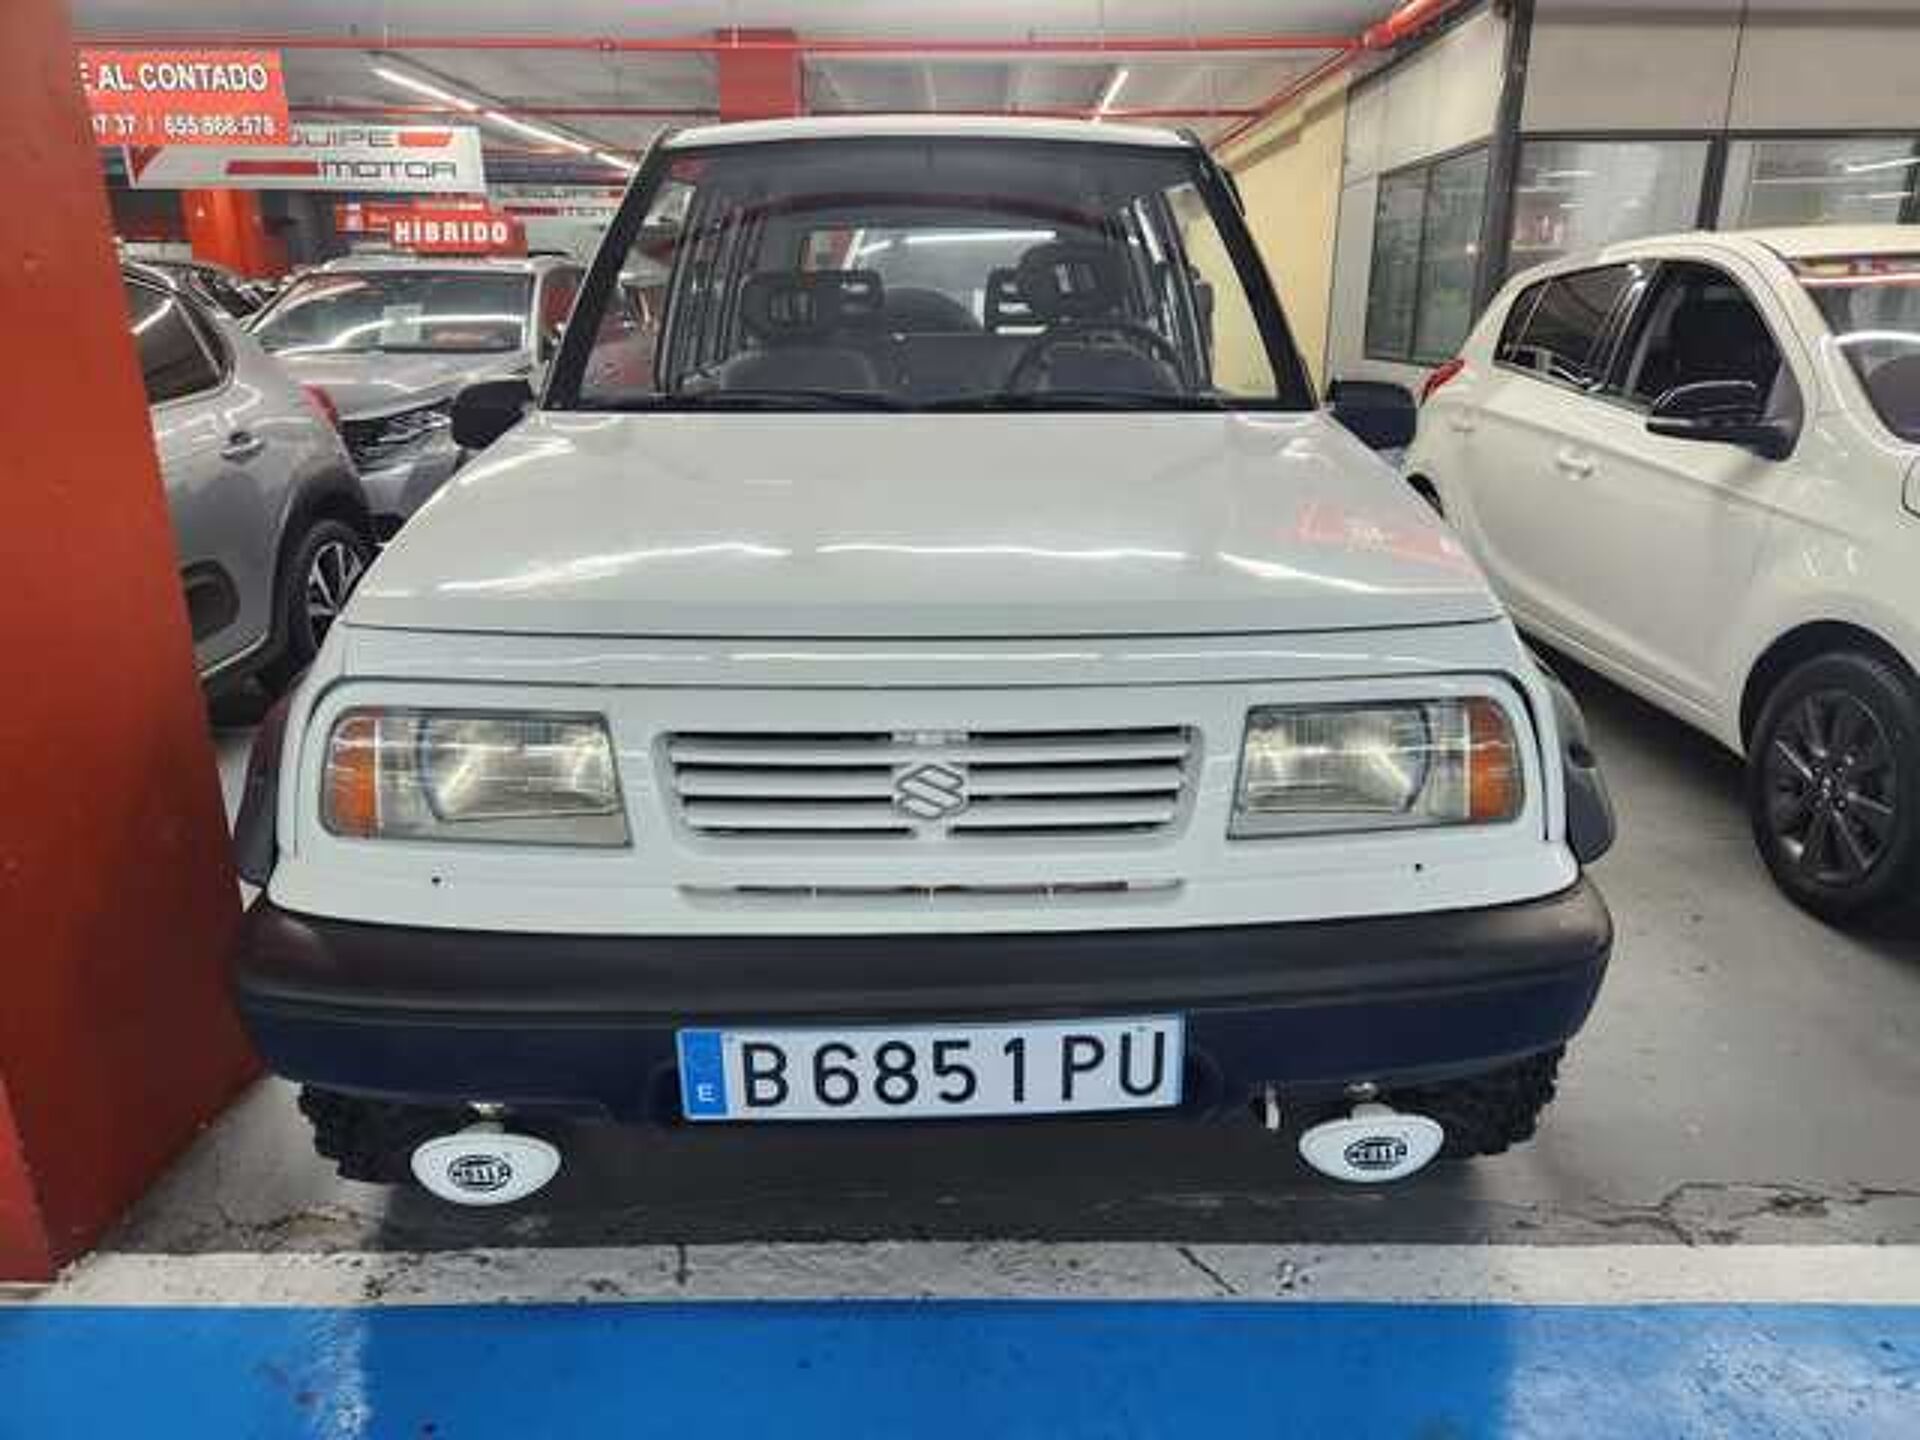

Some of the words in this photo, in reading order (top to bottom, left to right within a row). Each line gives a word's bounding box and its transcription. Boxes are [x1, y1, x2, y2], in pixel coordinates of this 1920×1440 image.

[98, 63, 133, 91] AL
[138, 62, 269, 91] CONTADO
[742, 1043, 788, 1107] B
[812, 1036, 1026, 1106] 6851
[1061, 1030, 1165, 1101] PU
[697, 1083, 716, 1103] E
